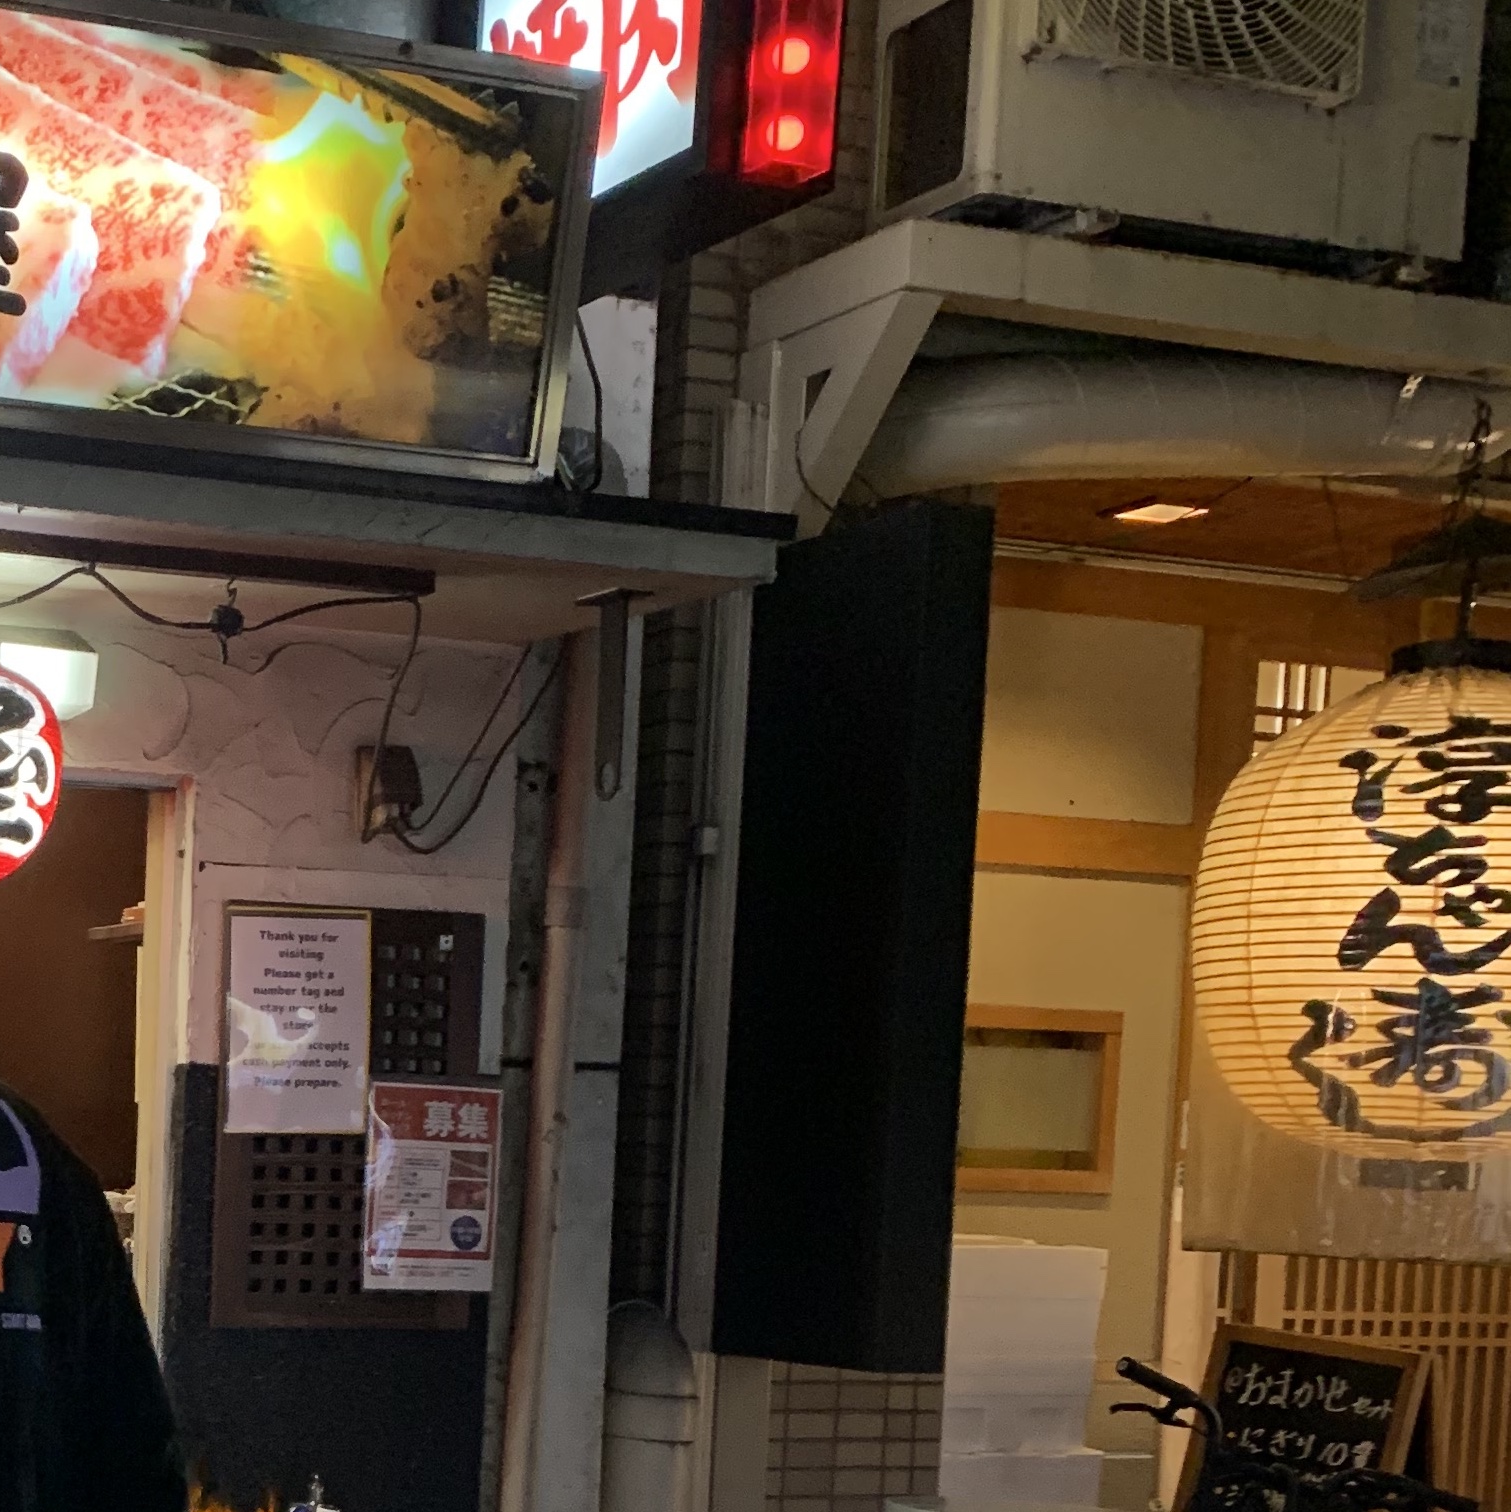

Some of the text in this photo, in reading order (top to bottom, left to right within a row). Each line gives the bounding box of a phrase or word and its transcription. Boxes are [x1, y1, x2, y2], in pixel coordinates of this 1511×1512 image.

[259, 931, 339, 943] Thank you for
[264, 968, 301, 978] Please
[305, 970, 325, 981] get
[253, 985, 344, 998] number tag and
[422, 1101, 489, 1139] 募集
